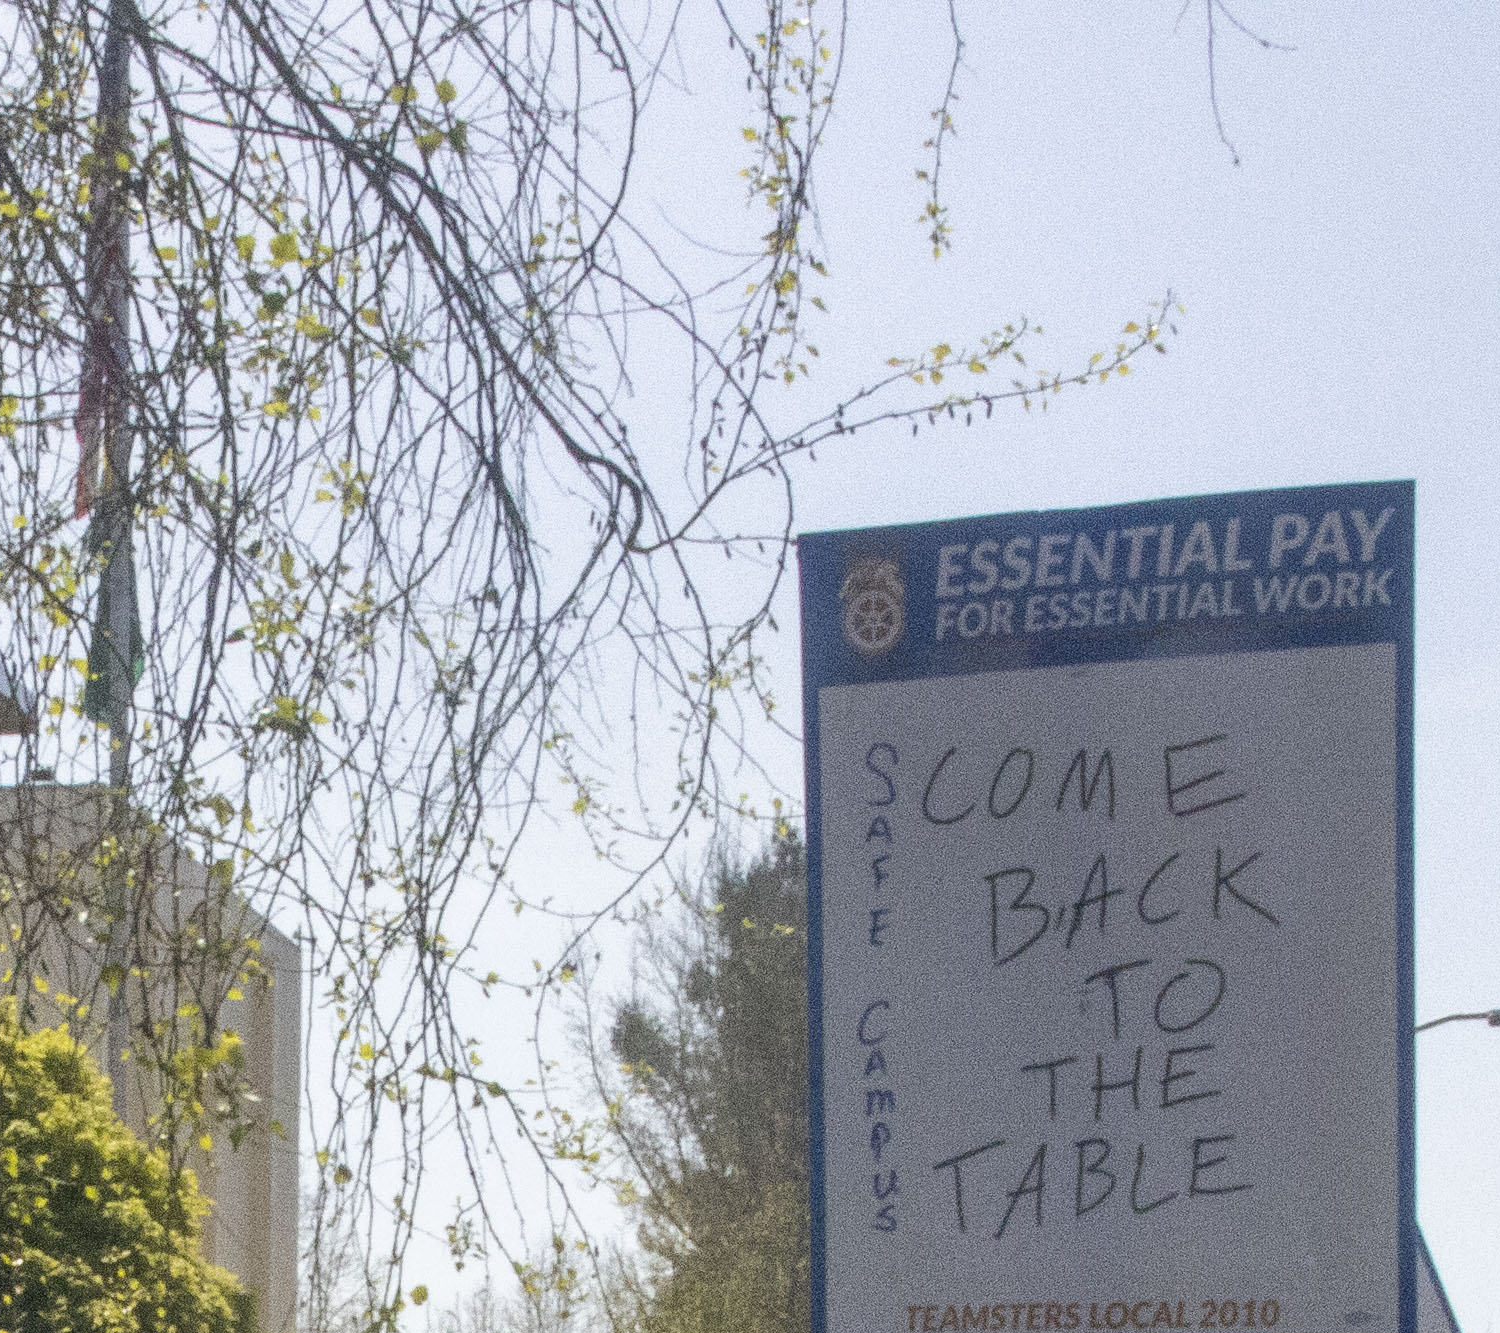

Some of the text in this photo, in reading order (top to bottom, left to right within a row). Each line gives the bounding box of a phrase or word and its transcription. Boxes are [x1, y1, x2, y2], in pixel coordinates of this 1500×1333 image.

[934, 507, 1396, 599] ESSENTIAL PAY
[934, 567, 1395, 642] FOR ESSENTIAL WORK
[920, 733, 1247, 826] COME
[864, 742, 899, 947] SAFE
[982, 846, 1281, 967] BACK
[1080, 957, 1227, 1040] TO
[1020, 1043, 1223, 1122] THE
[932, 1131, 1255, 1240] TABLE
[904, 1298, 1282, 1333] TEAMSTERS LOCAL 2010
